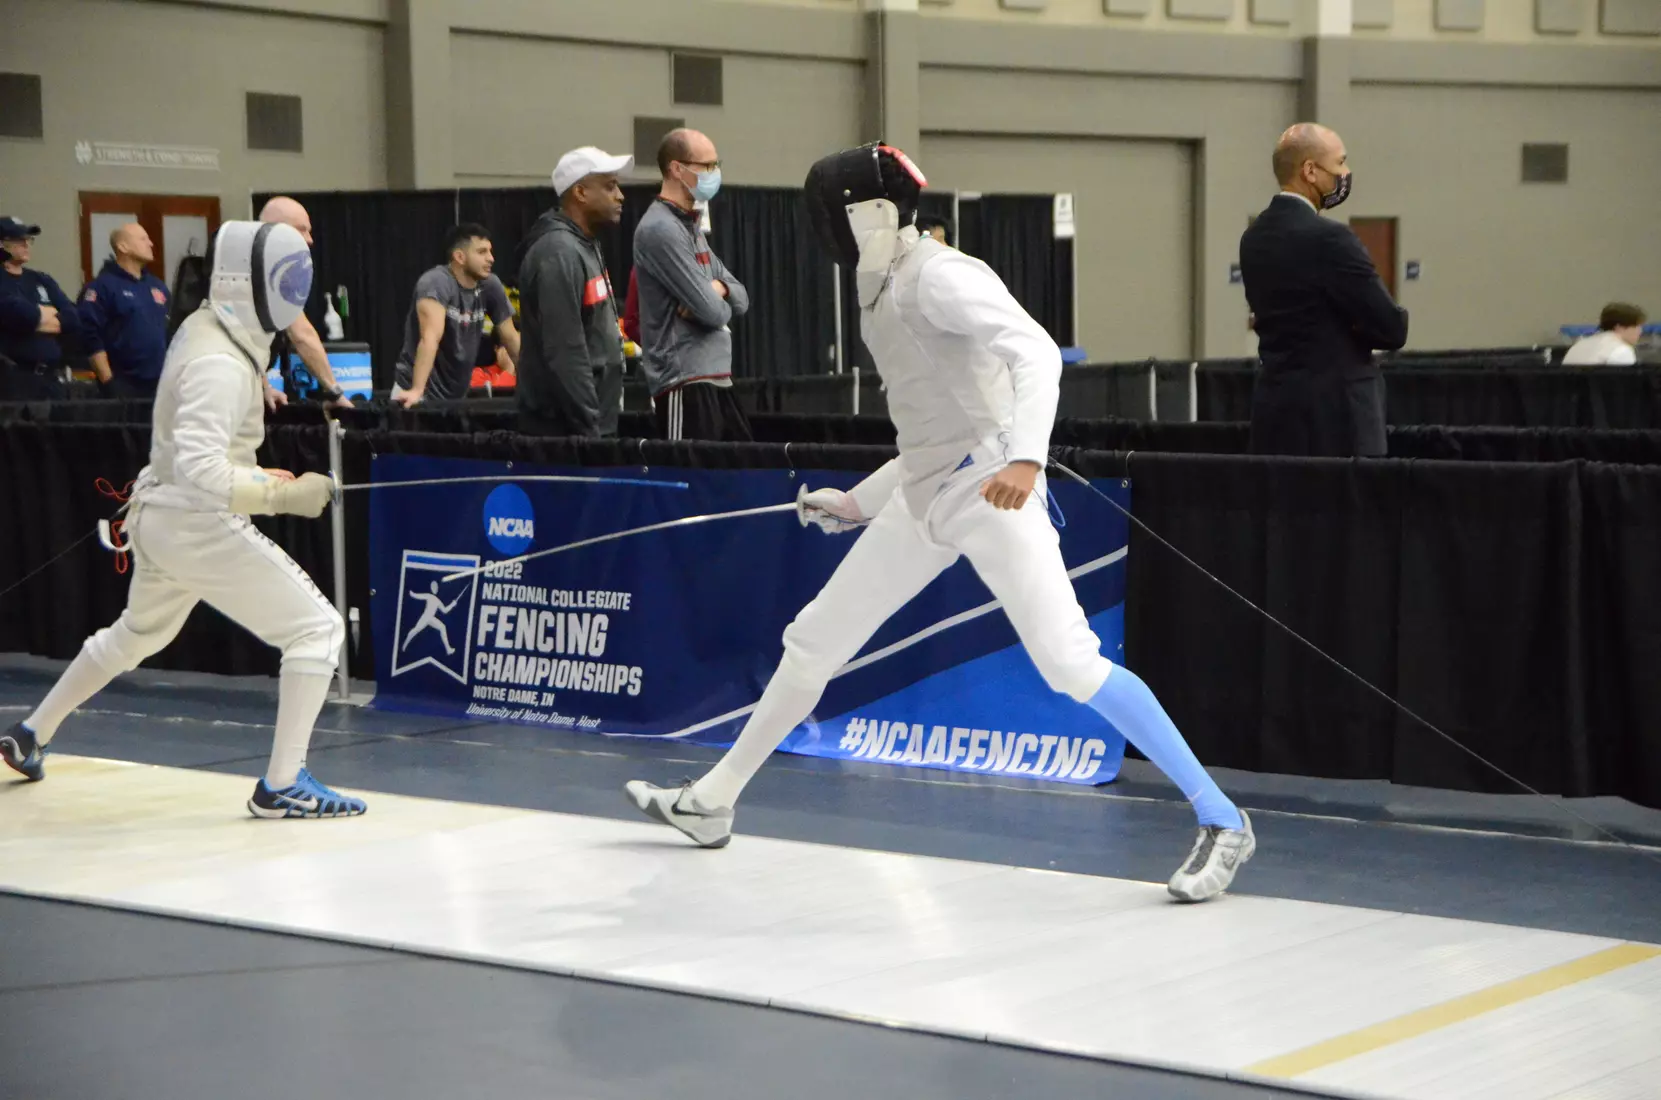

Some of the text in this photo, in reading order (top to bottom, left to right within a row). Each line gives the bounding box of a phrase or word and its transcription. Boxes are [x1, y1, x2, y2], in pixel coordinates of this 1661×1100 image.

[488, 517, 534, 538] NCAA
[484, 560, 523, 580] 2022
[482, 582, 632, 611] NATIONAL COLLEGIATE
[477, 606, 609, 657] FENCING
[474, 652, 643, 696] CHAMPIONSHIPS
[473, 685, 555, 707] NOTRE DAME, IN
[466, 702, 602, 729] University of Notre Dame, Host
[839, 717, 1107, 780] #NCAAFENCING
